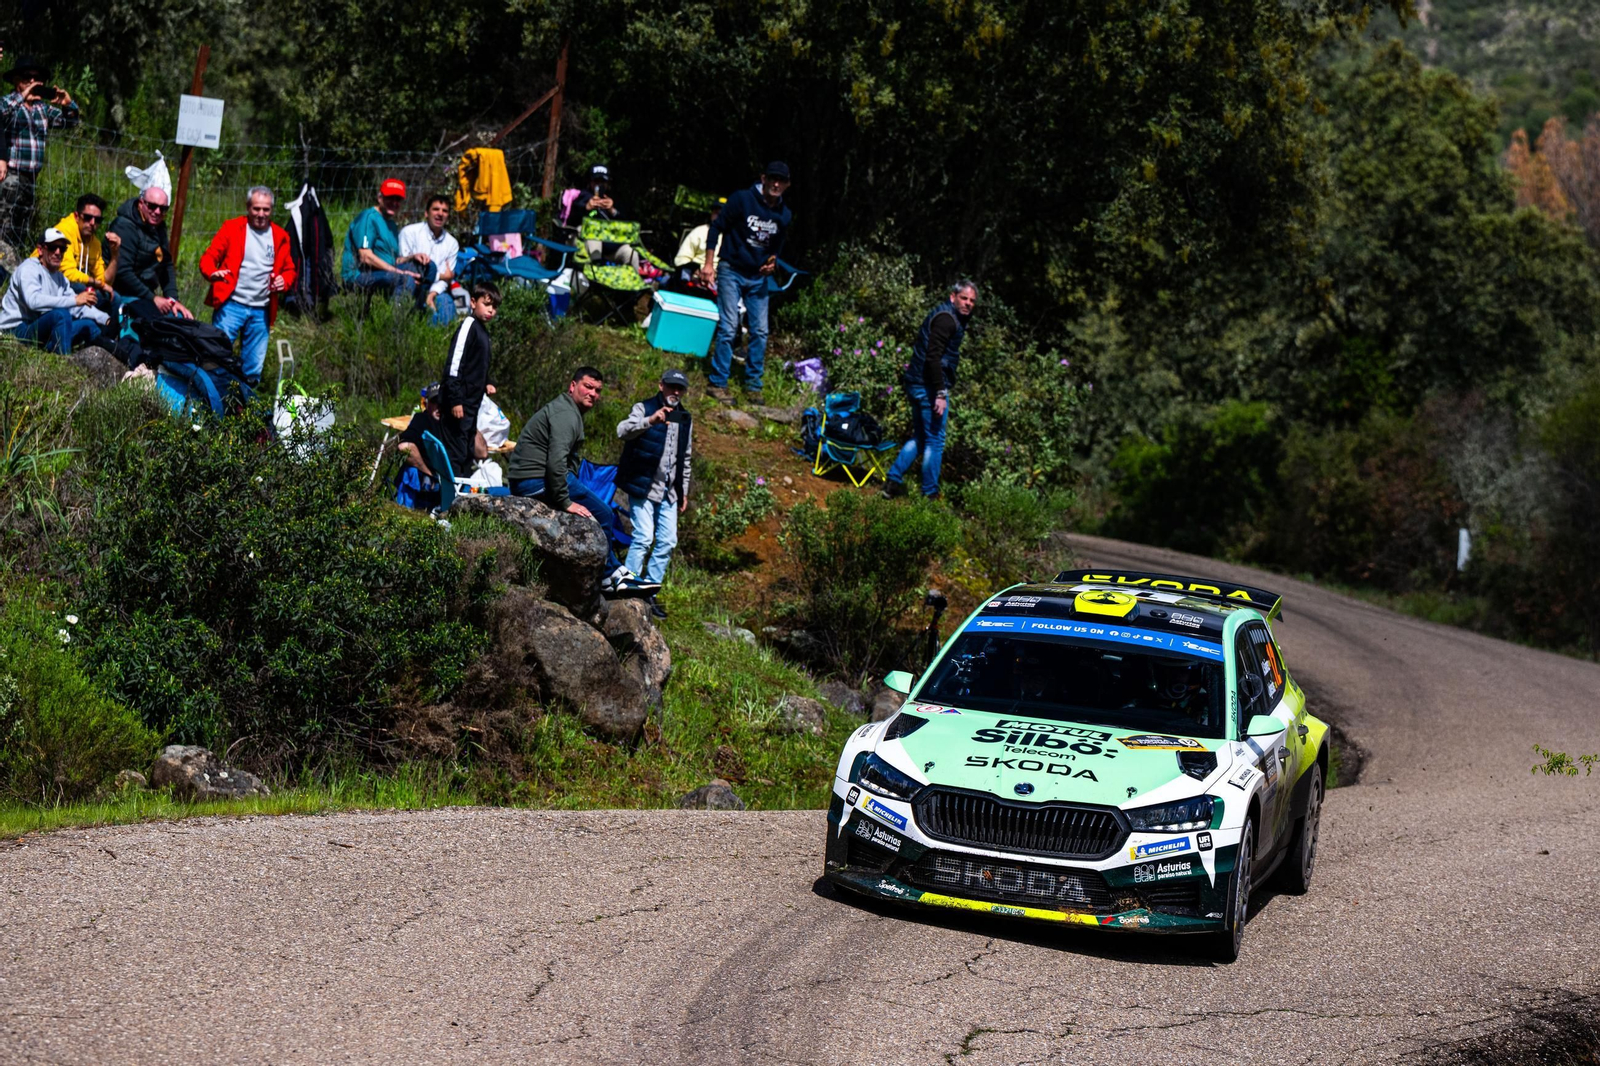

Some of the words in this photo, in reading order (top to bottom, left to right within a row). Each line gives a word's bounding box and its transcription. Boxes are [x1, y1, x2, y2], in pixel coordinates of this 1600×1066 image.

[1031, 622, 1072, 632] FOLLOW
[1001, 721, 1107, 741] MOTUL
[1003, 744, 1076, 761] Telecom
[874, 806, 903, 825] MICHELIN
[873, 826, 901, 847] Asturias
[1198, 835, 1210, 844] UFI
[1148, 841, 1186, 854] MICHELIN
[1157, 861, 1191, 874] Asturias
[1175, 869, 1192, 877] natural
